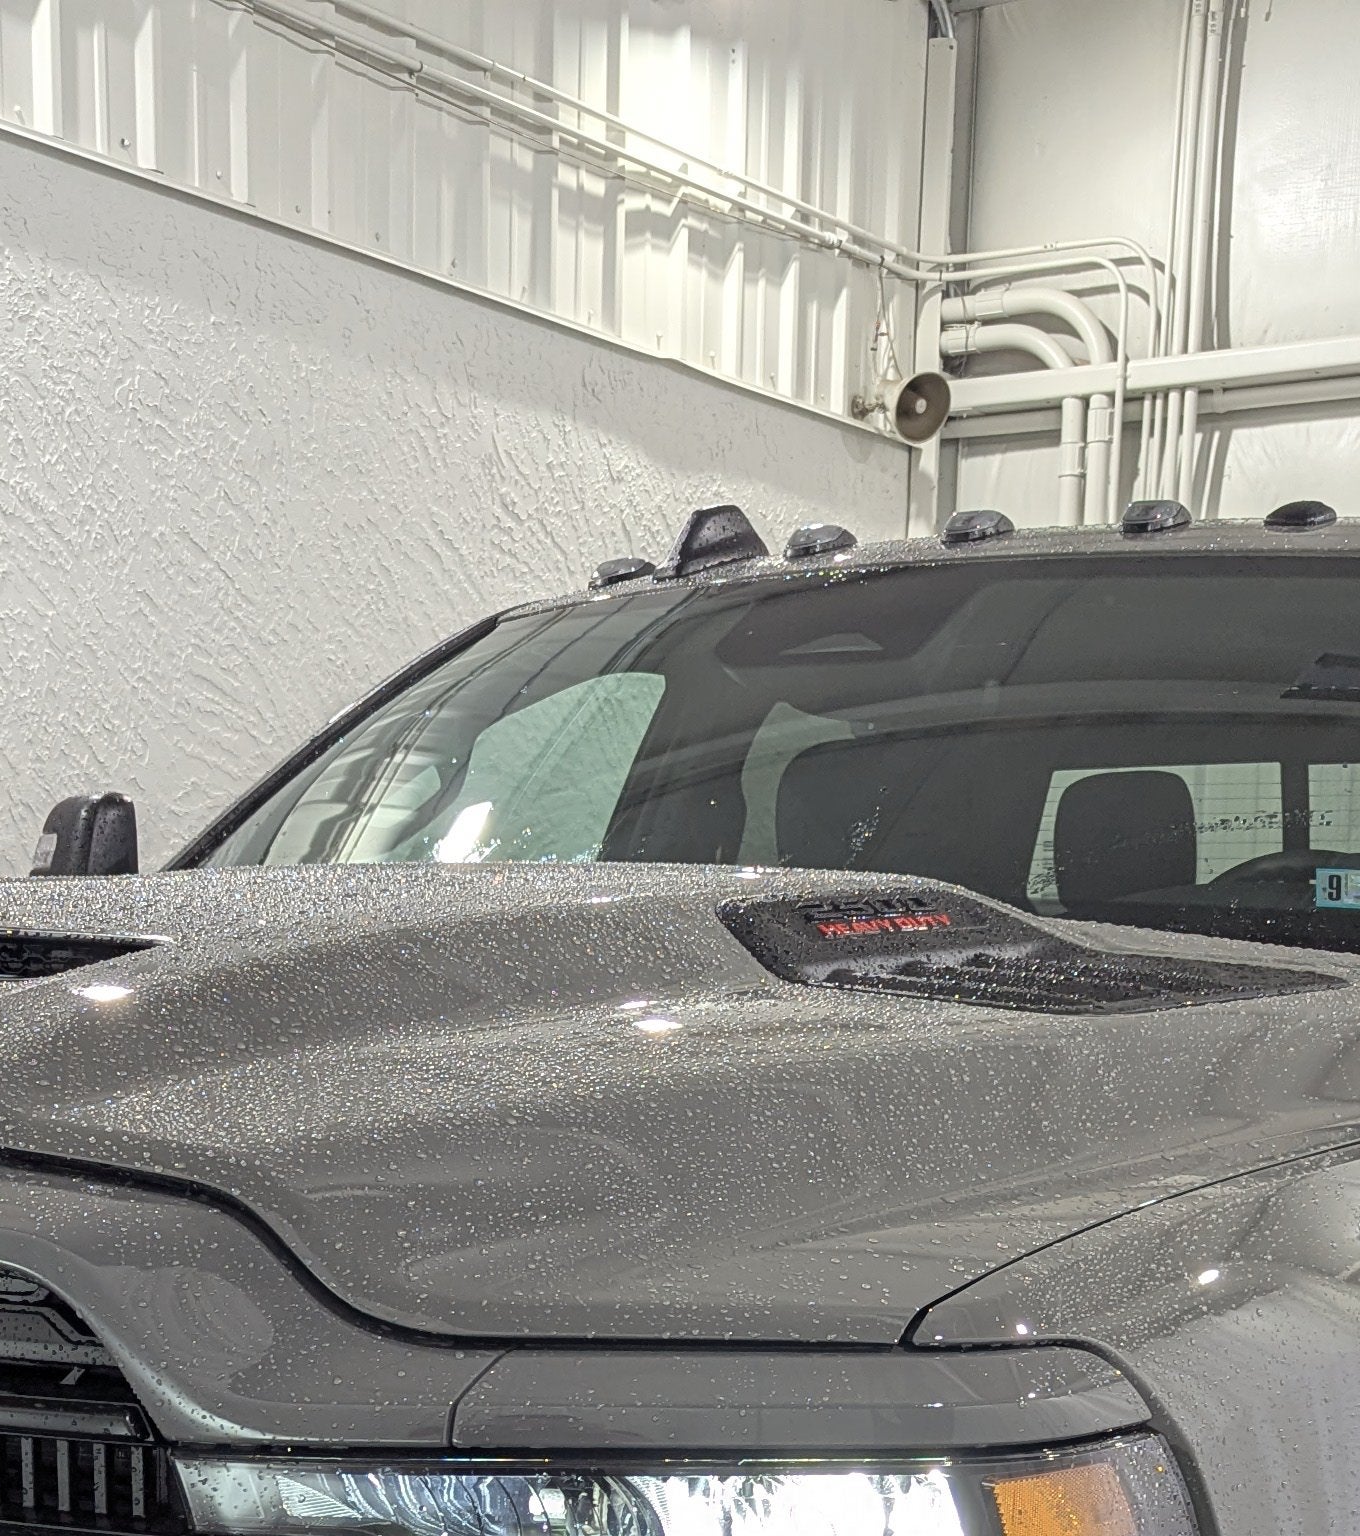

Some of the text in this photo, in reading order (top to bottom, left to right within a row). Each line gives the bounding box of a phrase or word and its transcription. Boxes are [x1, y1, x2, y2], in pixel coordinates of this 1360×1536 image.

[1327, 874, 1342, 901] 9
[816, 912, 951, 938] HEAVY DUTY
